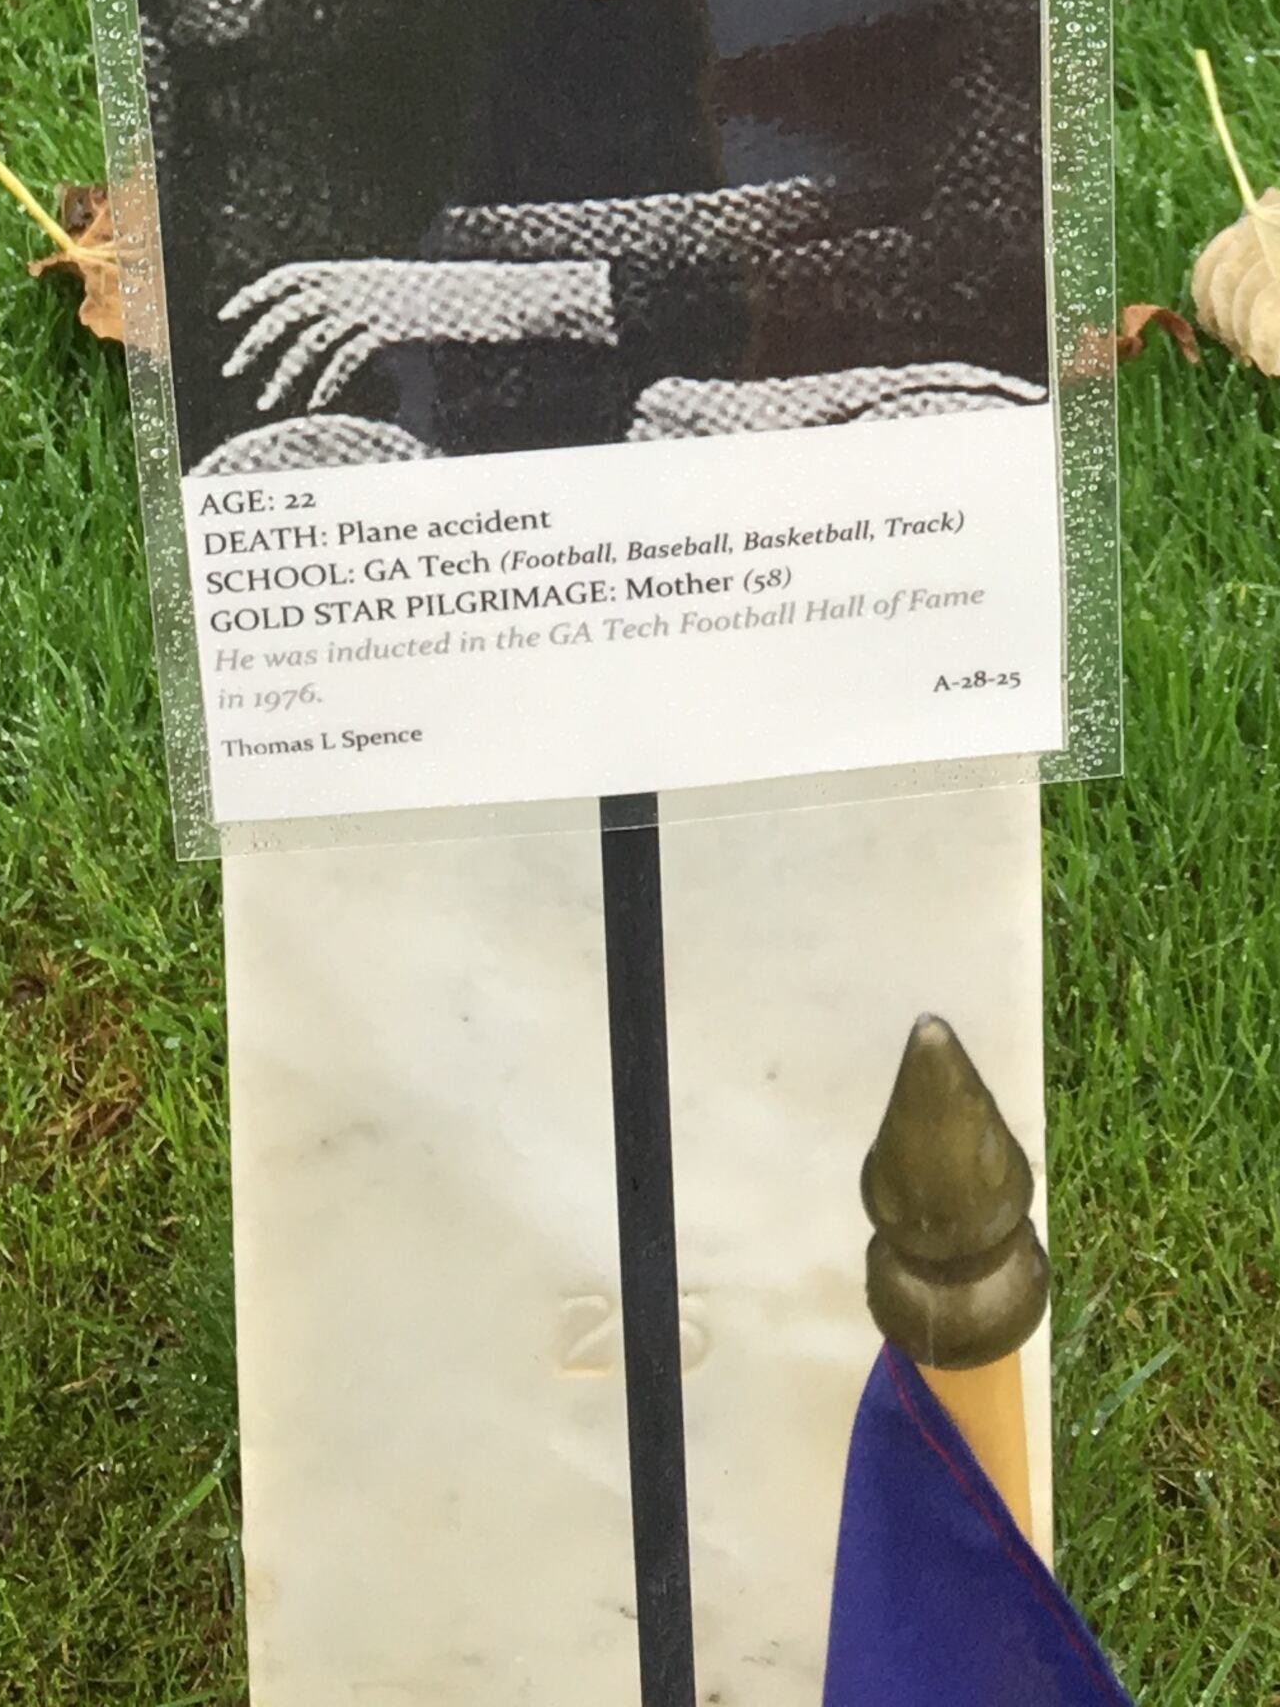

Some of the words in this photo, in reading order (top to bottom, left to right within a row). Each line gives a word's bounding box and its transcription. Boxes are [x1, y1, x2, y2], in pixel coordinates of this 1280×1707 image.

[199, 491, 276, 517] AGE:
[284, 493, 317, 512] 22
[204, 525, 328, 556] DEATH:
[337, 519, 419, 547] Plane
[428, 509, 552, 538] accident
[206, 563, 356, 595] SCHOOL:
[364, 557, 411, 583] GA
[419, 550, 490, 579] Tech
[501, 542, 617, 574] (Football,
[627, 533, 734, 563] Baseball,
[744, 520, 875, 553] Basketball,
[885, 510, 966, 539] Track)
[210, 604, 303, 634] GOLD
[314, 596, 396, 626] STAR
[406, 580, 617, 619] PILGRIMAGE:
[626, 572, 734, 601] Mother
[744, 567, 793, 595] (58)
[215, 648, 256, 673] He
[265, 647, 318, 669] was
[327, 633, 450, 665] inducted
[460, 631, 487, 654] in
[496, 624, 541, 652] the
[549, 619, 594, 646] GA
[602, 614, 671, 644] Tech
[680, 604, 796, 636] Football
[805, 594, 865, 624] Hall
[873, 589, 907, 619] of
[909, 585, 985, 614] Fame
[219, 688, 246, 712] in
[254, 683, 324, 715] 1976.
[933, 669, 1022, 694] A-28-25
[221, 733, 315, 759] Thomas
[321, 731, 336, 752] L
[342, 726, 423, 752] Spence
